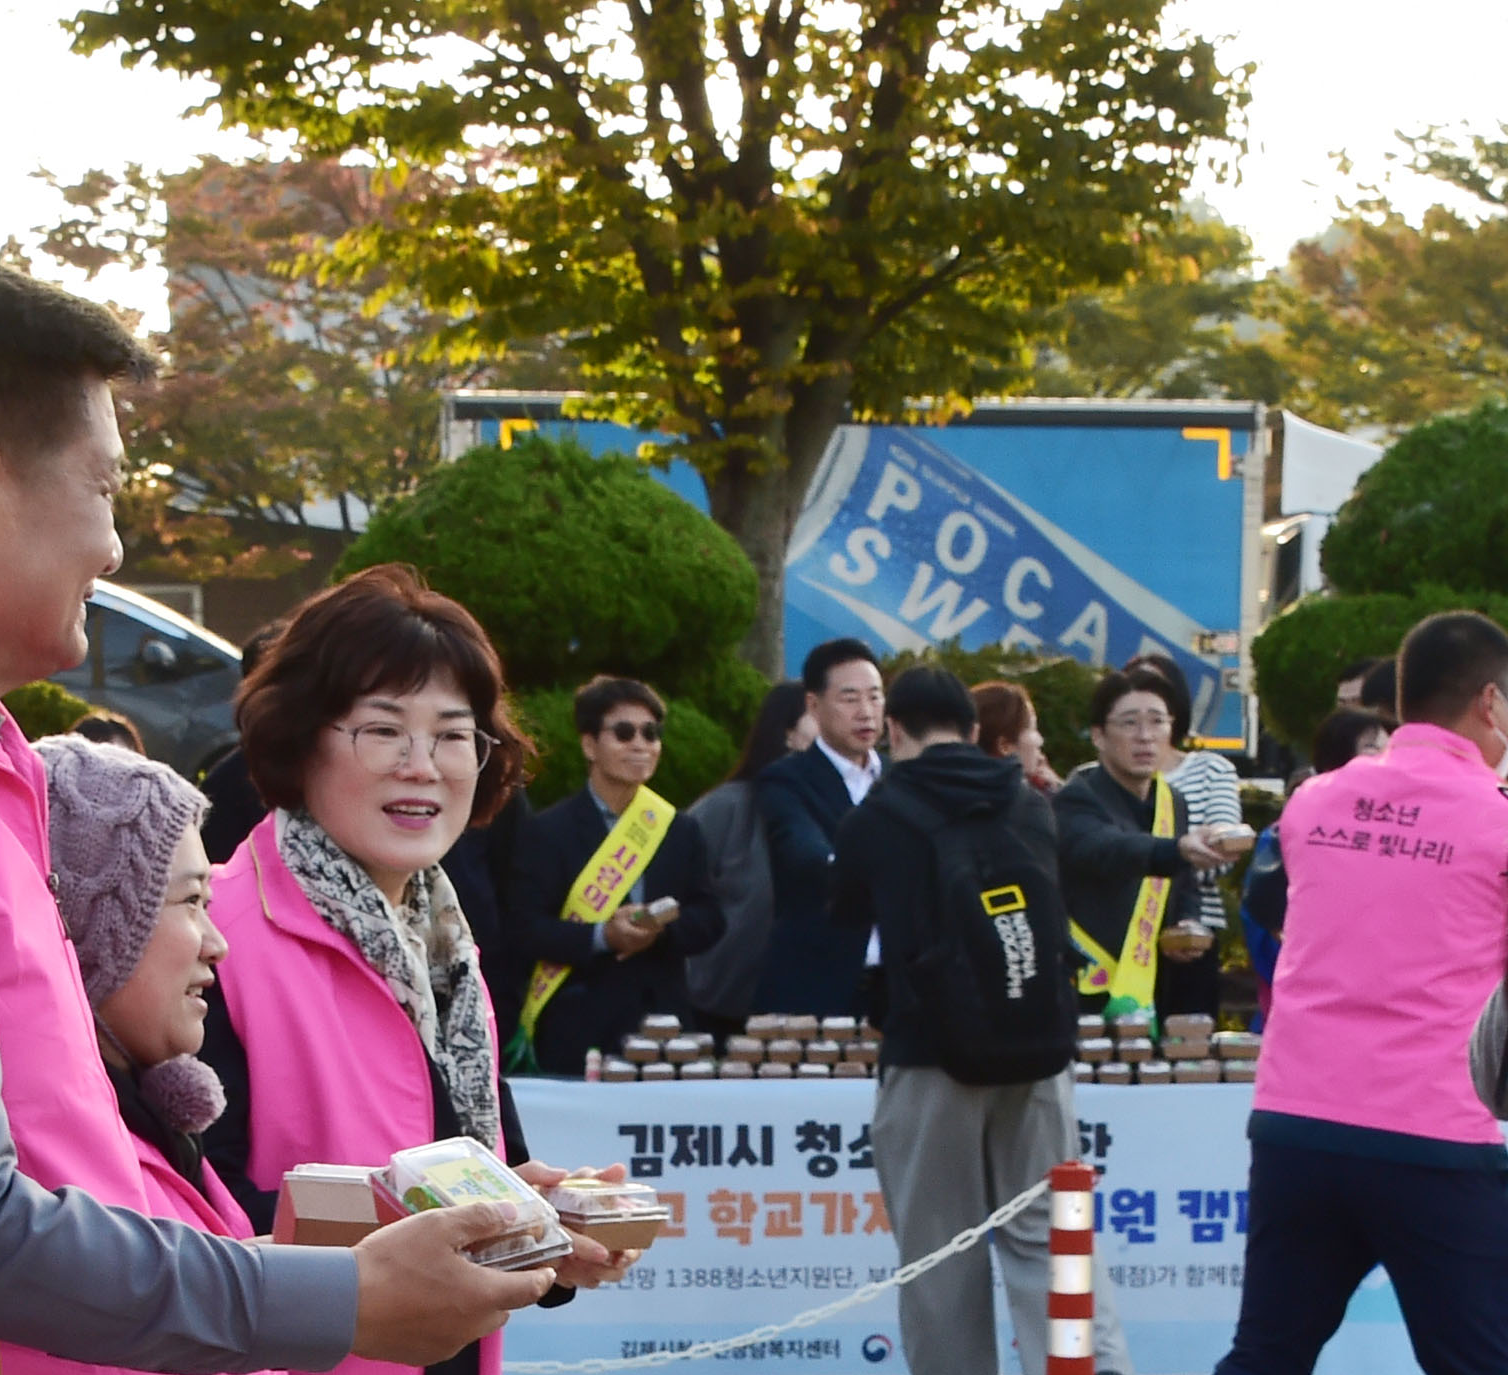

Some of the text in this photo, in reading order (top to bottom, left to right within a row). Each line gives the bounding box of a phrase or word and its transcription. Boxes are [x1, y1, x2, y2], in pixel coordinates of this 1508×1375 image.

[1353, 798, 1420, 828] 청소년
[1306, 825, 1455, 866] 스스로 빛나리!
[618, 1123, 775, 1178] 김제시
